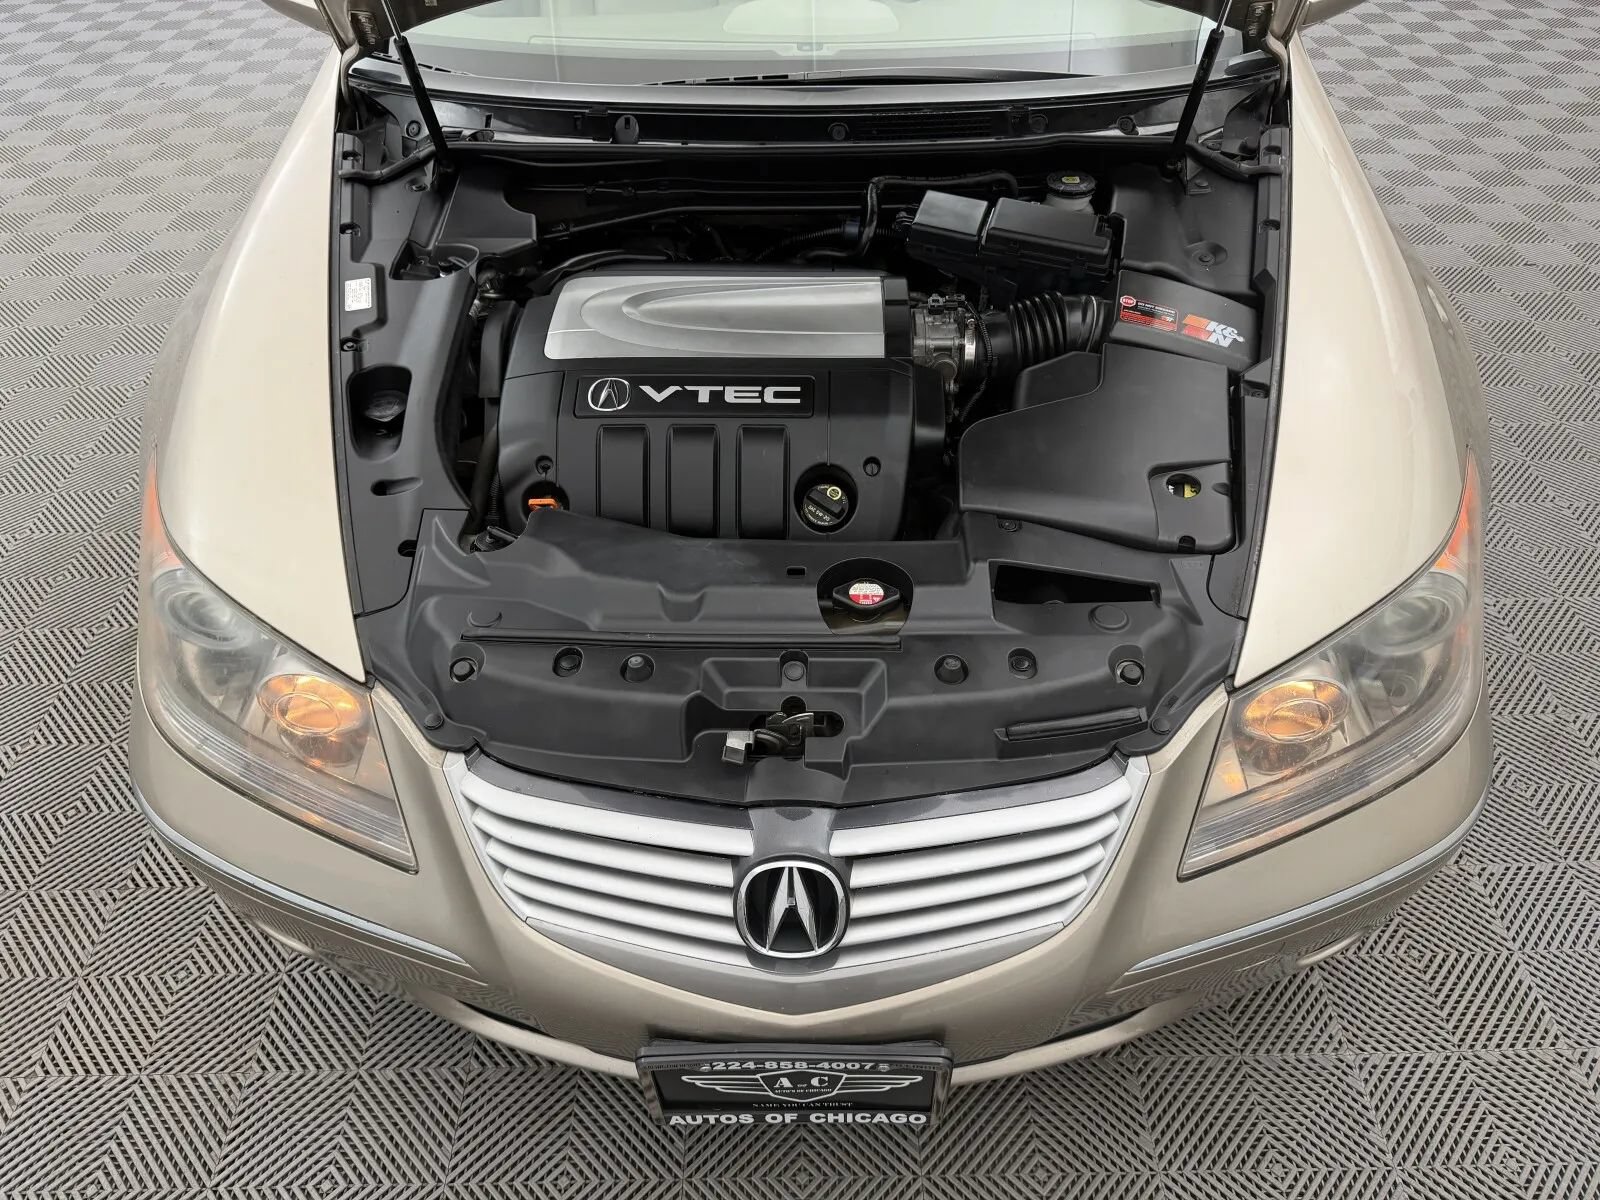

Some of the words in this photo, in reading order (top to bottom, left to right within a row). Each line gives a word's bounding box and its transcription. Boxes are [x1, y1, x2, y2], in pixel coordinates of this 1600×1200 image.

[639, 385, 801, 404] VTEC
[712, 1061, 875, 1070] 224-858-4007
[773, 1077, 794, 1088] A
[810, 1076, 829, 1087] C
[669, 1113, 755, 1125] AUTOS
[764, 1113, 799, 1124] OF
[809, 1112, 927, 1124] CHICAGO
